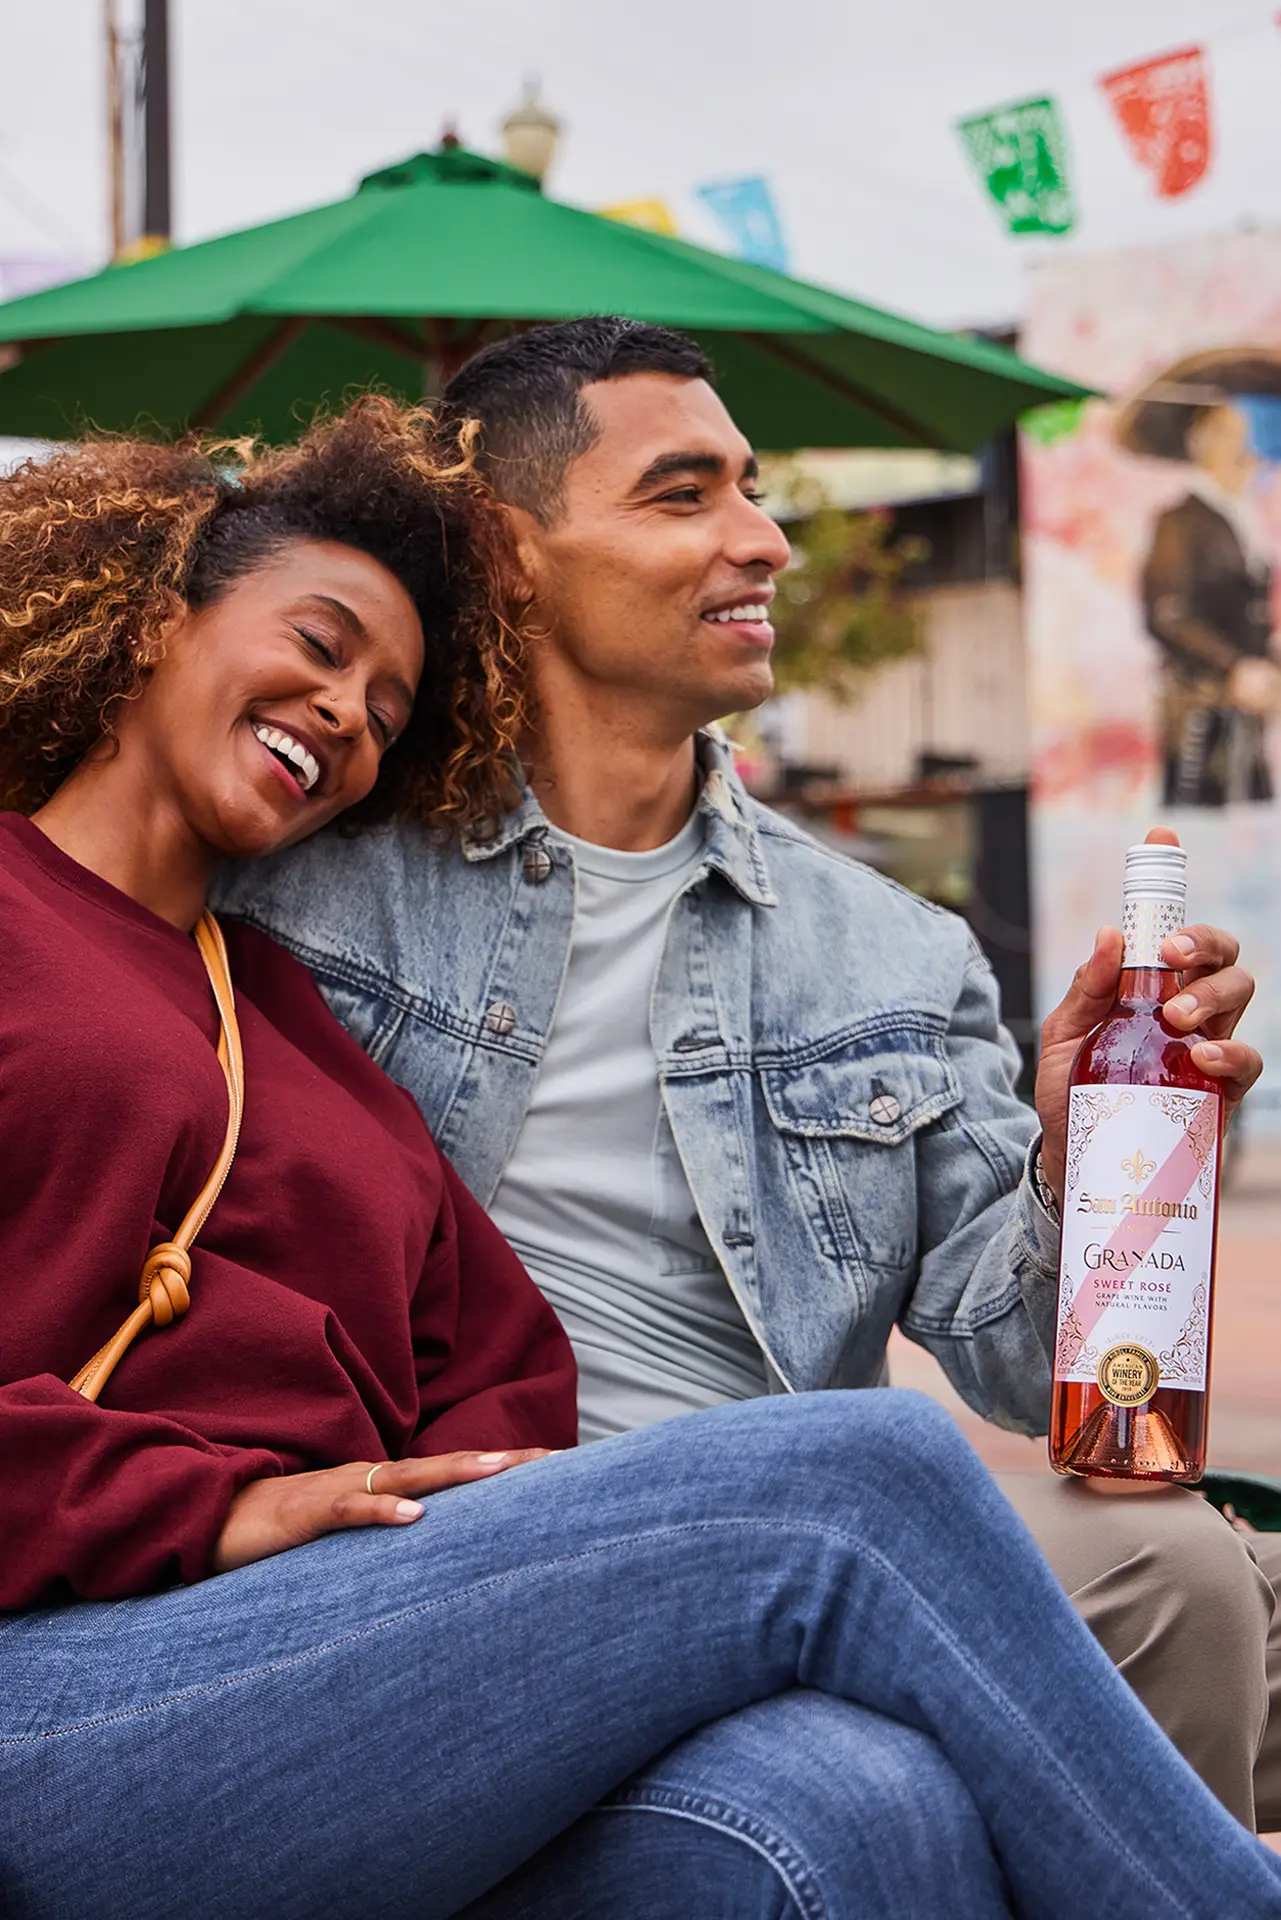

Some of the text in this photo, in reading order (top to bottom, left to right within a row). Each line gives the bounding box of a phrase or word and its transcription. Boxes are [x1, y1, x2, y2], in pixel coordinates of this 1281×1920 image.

[1077, 1192, 1198, 1220] San Antonio
[1083, 1243, 1185, 1272] GRANADA
[1093, 1279, 1134, 1290] SWEET
[1096, 1292, 1120, 1300] GRAPE
[1095, 1301, 1168, 1312] NATURAL FLAVORS
[1111, 1368, 1143, 1380] WINERY
